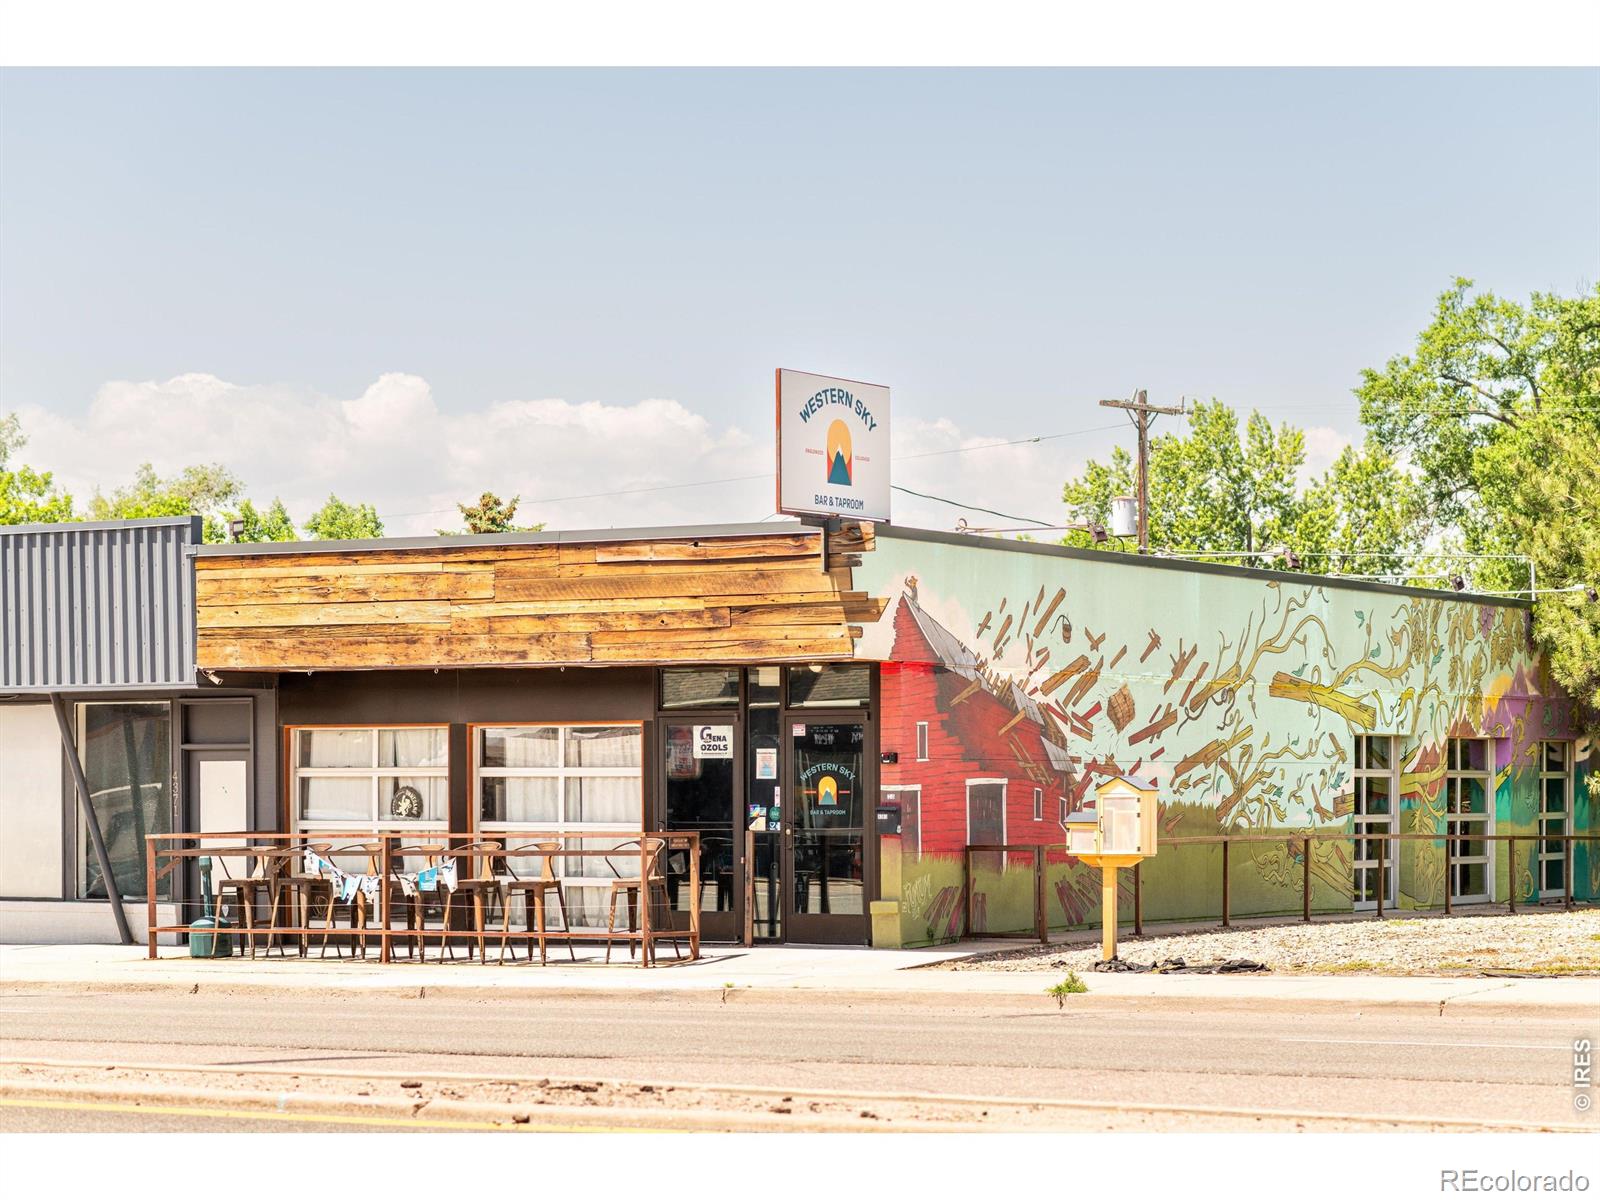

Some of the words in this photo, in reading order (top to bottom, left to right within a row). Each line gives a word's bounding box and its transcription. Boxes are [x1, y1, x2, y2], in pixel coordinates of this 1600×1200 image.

[799, 388, 853, 423] WESTERN
[855, 399, 877, 432] SKY
[814, 494, 828, 505] BAR
[829, 496, 834, 506] &
[835, 497, 864, 510] TAPROOM
[800, 762, 839, 781] WESTERN
[839, 766, 856, 780] SKY
